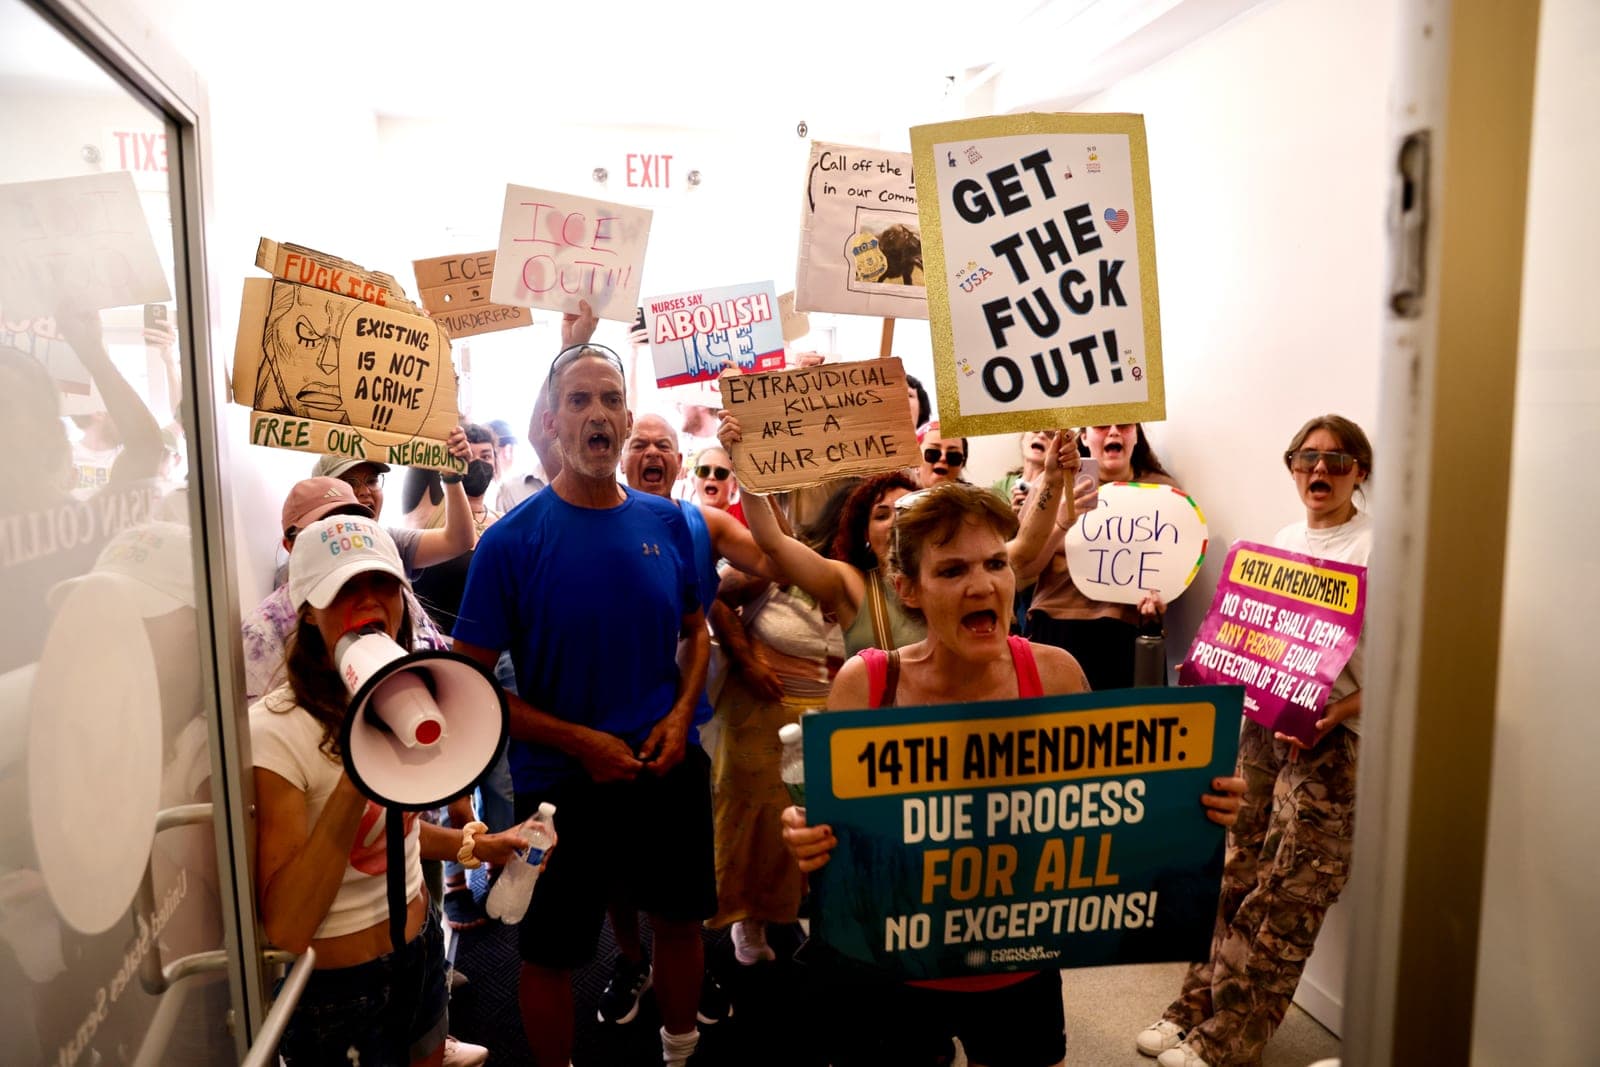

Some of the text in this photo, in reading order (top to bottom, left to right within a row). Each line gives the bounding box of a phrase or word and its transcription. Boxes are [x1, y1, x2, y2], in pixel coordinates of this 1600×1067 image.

[626, 154, 673, 188] EXIT
[819, 151, 902, 176] Call off the
[952, 148, 1057, 225] GET
[824, 182, 837, 195] in
[847, 187, 873, 197] our
[513, 202, 623, 256] ICE
[990, 203, 1103, 284] THE
[284, 253, 388, 307] FUCK ICE
[440, 256, 493, 281] ICE
[959, 267, 993, 293] USA
[651, 294, 703, 314] NURSES SAY
[655, 292, 772, 344] ABOLISH
[982, 259, 1128, 349] FUCK
[356, 317, 430, 352] EXISTING
[682, 323, 757, 377] ICE
[357, 351, 430, 382] IS NOT
[728, 367, 895, 404] EXTRAJUDICIAL
[981, 329, 1123, 403] OUT!
[354, 375, 424, 410] A CRIME
[783, 390, 884, 417] KILLINGS
[253, 417, 310, 447] FREE
[327, 428, 366, 459] OUR
[370, 403, 394, 431] !!!
[762, 414, 841, 439] ARE A
[751, 435, 897, 475] WAR CRIME
[1081, 498, 1179, 545] Crush
[1086, 548, 1163, 593] ICE
[1240, 557, 1351, 609] 14TH AMENDMENT:
[1219, 592, 1347, 651] NO STATE SHALL DENY
[1215, 621, 1324, 677] ANY PERSON EQUAL
[1191, 640, 1262, 686] PROTECTION
[1256, 664, 1277, 690] OF
[1269, 670, 1298, 700] THE
[1290, 677, 1324, 713] LAW.
[857, 716, 1188, 788] 14TH AMENDMENT:
[903, 778, 1146, 845] DUE PROCESS
[921, 832, 1120, 905] FOR ALL
[885, 890, 1158, 953] NO EXCEPTIONS!
[991, 945, 1044, 956] POPULAR
